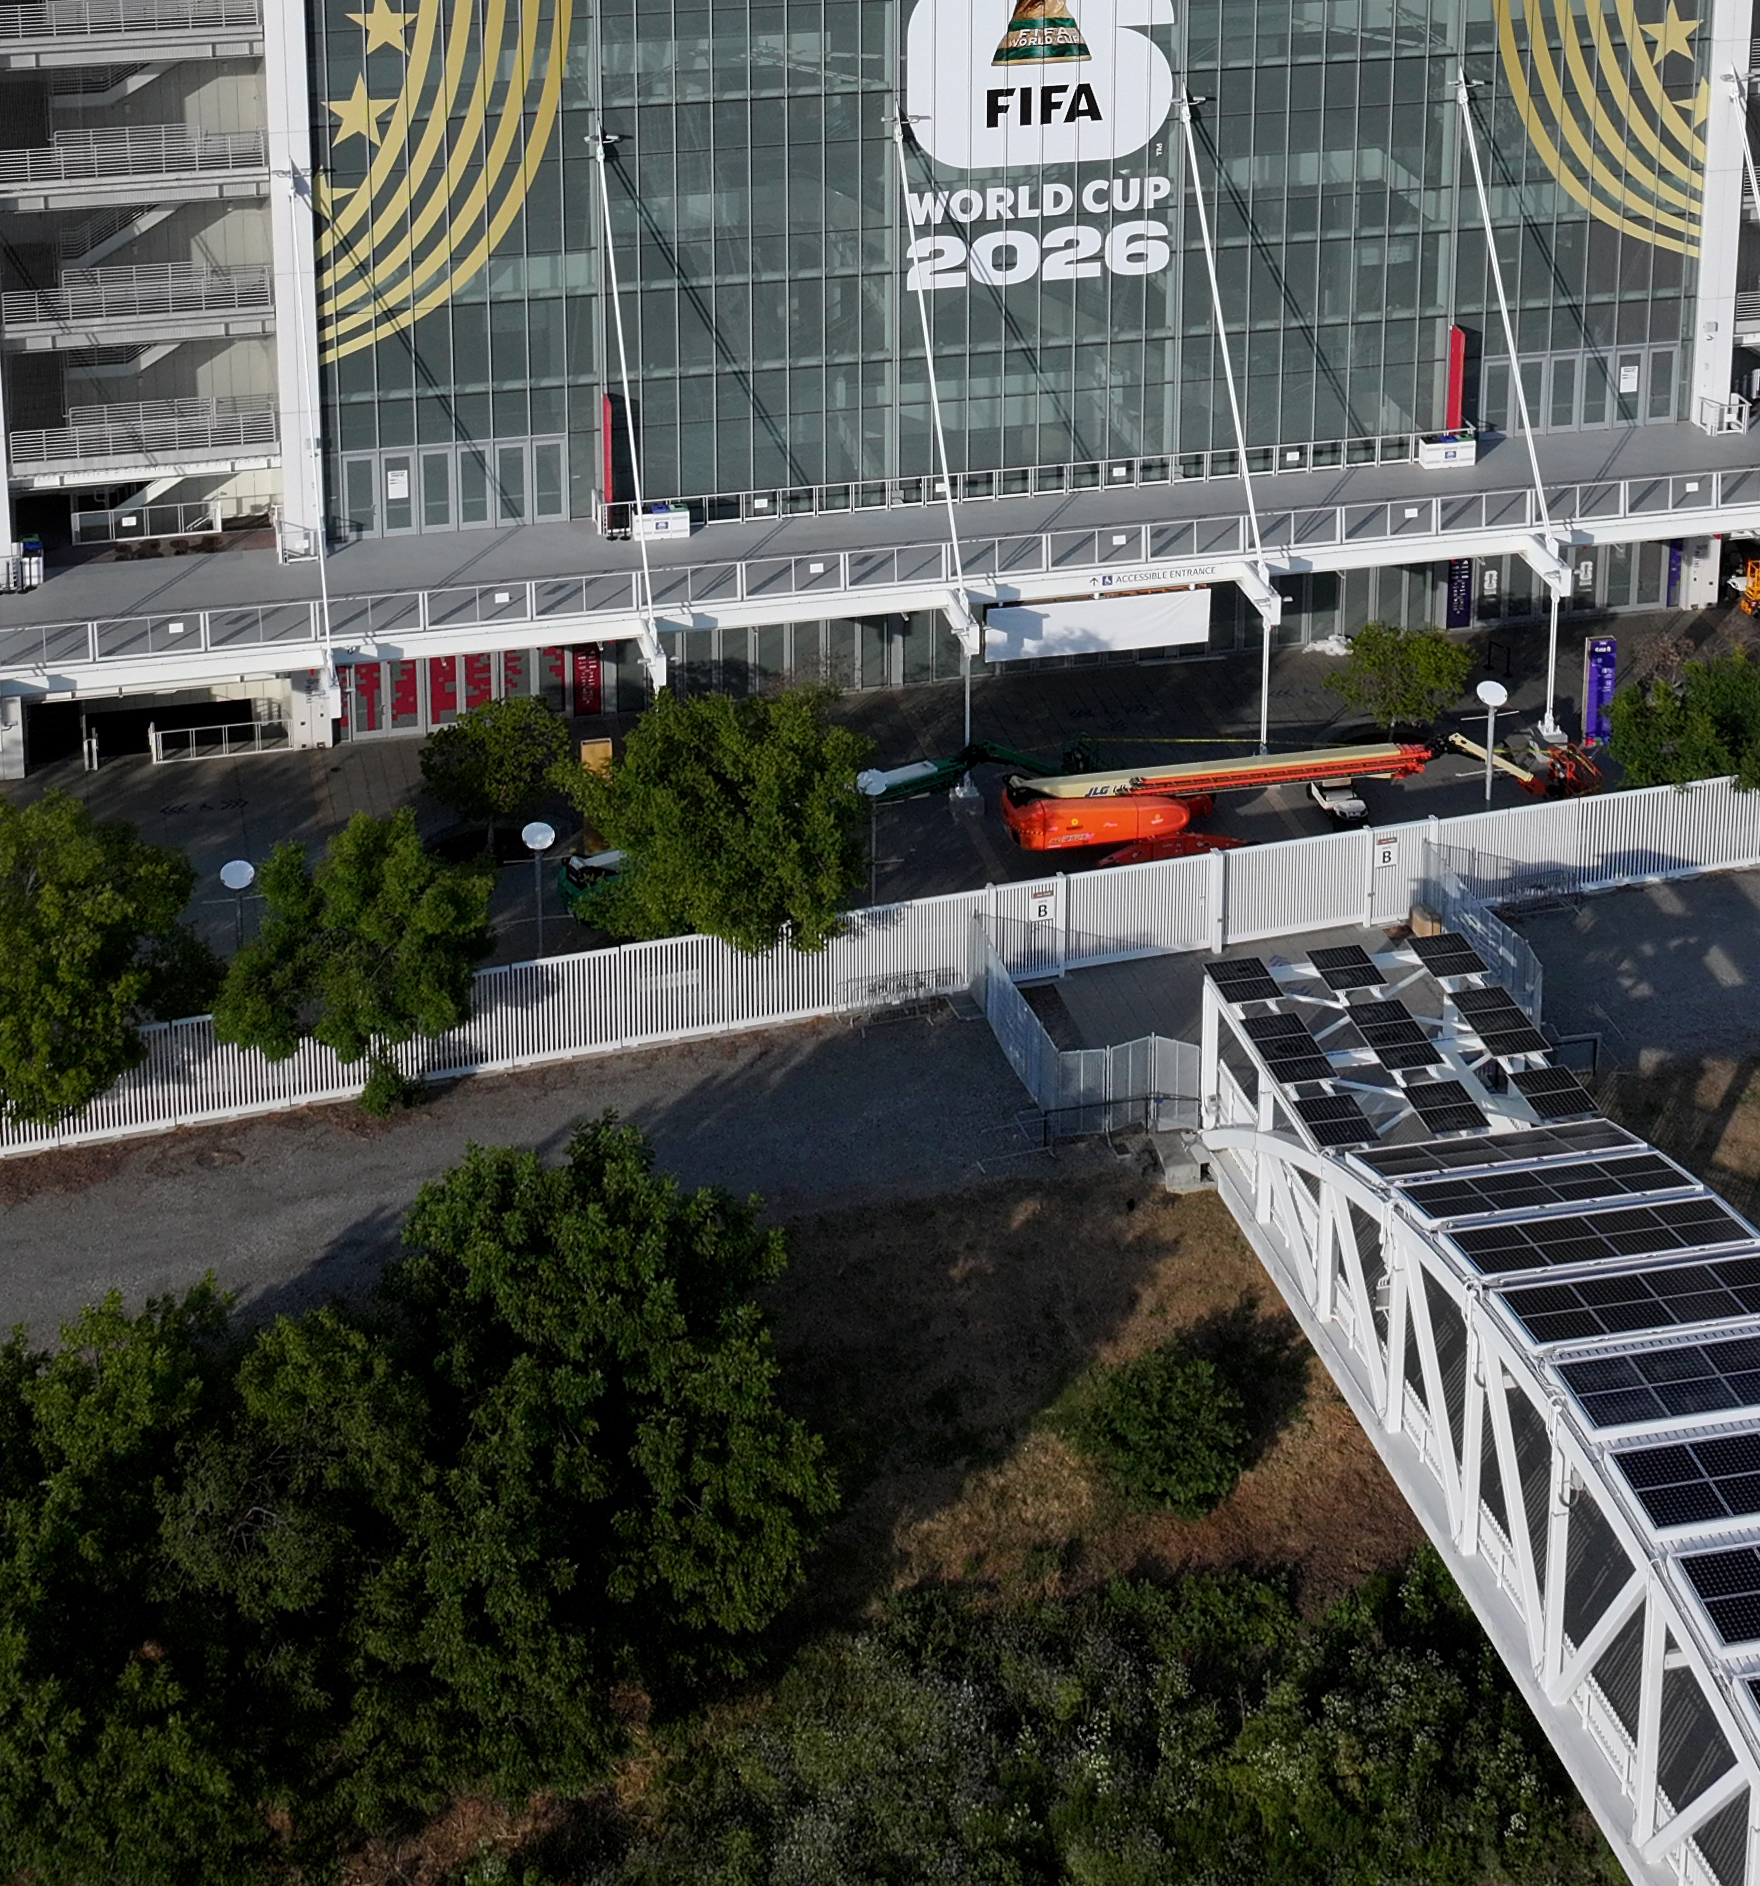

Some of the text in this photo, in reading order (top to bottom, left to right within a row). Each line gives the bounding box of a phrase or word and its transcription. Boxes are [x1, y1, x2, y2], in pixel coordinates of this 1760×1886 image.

[1018, 26, 1070, 38] FIFA
[1008, 35, 1054, 48] WORLD
[986, 82, 1103, 129] FIFA
[905, 175, 1171, 225] WORLD CUP
[905, 220, 1171, 291] 2026
[1116, 566, 1216, 584] ACCESSIBLE ENTRANCE
[1085, 785, 1110, 798] JLG
[1382, 850, 1392, 864] B
[1038, 904, 1048, 918] B
